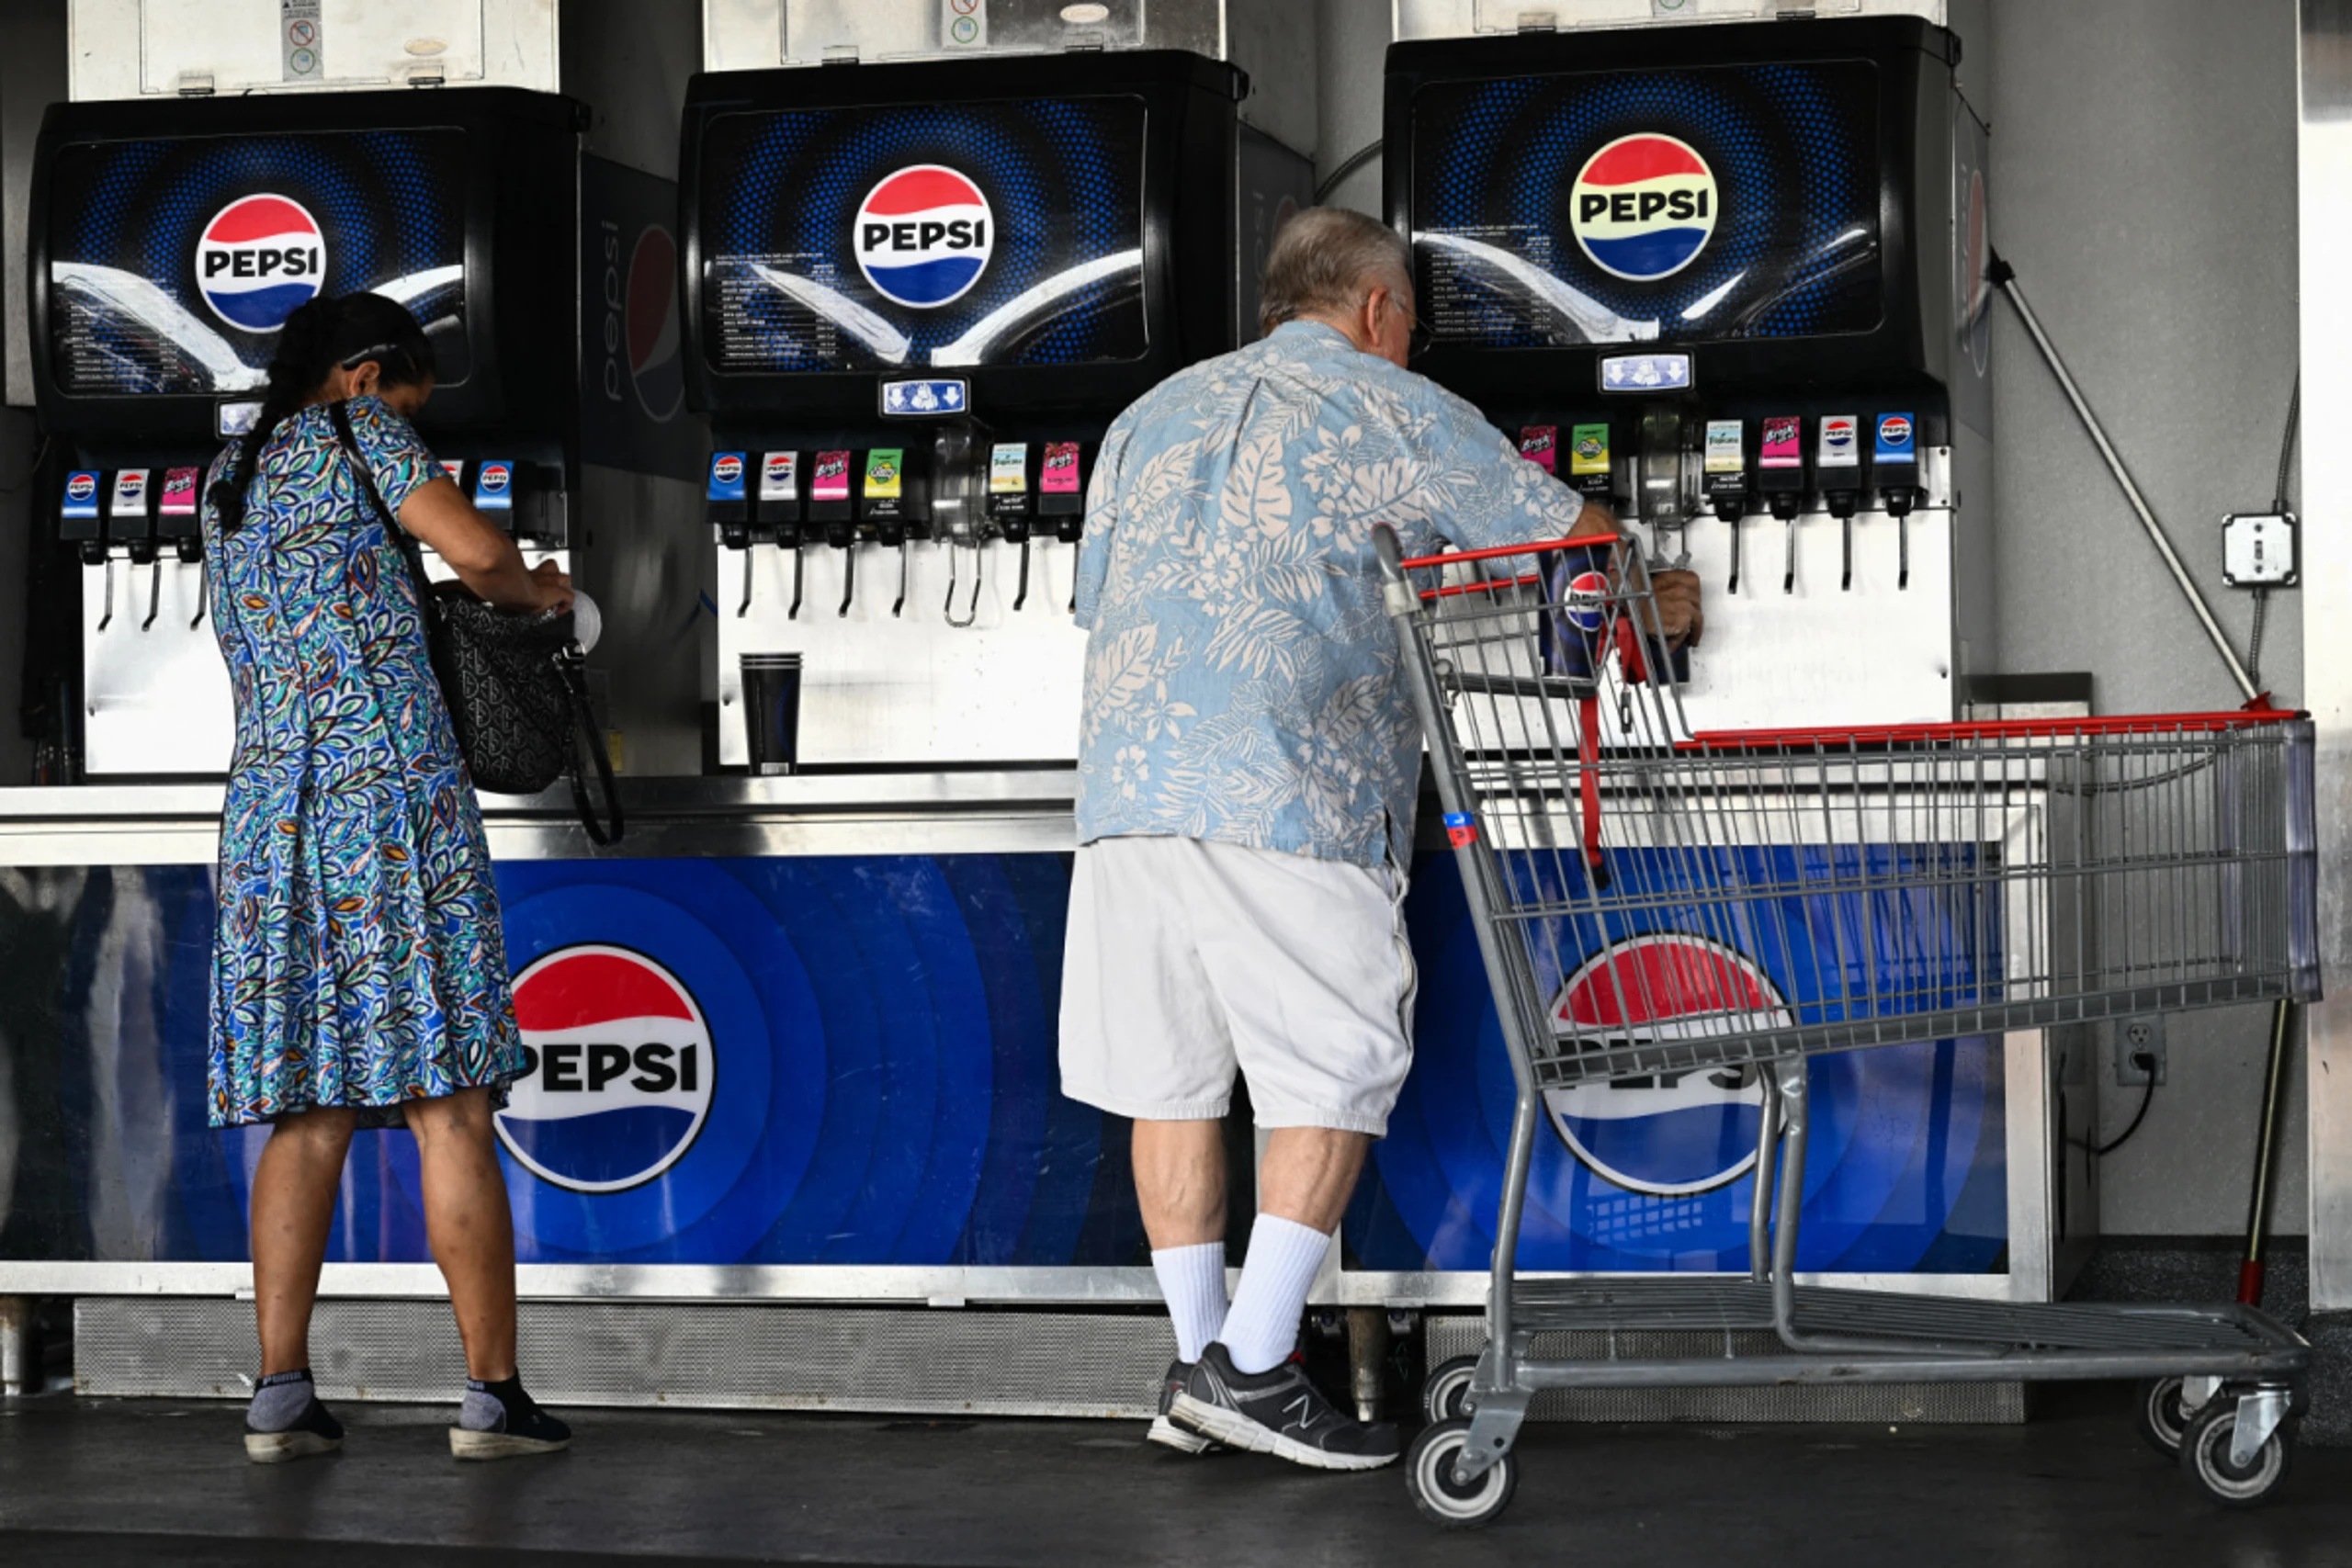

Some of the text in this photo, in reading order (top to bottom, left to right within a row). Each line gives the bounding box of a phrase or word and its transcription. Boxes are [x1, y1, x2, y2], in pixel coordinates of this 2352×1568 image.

[1579, 188, 1709, 223] PEPSI
[863, 219, 985, 252] PEPSI
[205, 247, 318, 278] PEPSI
[601, 220, 623, 402] pepsi
